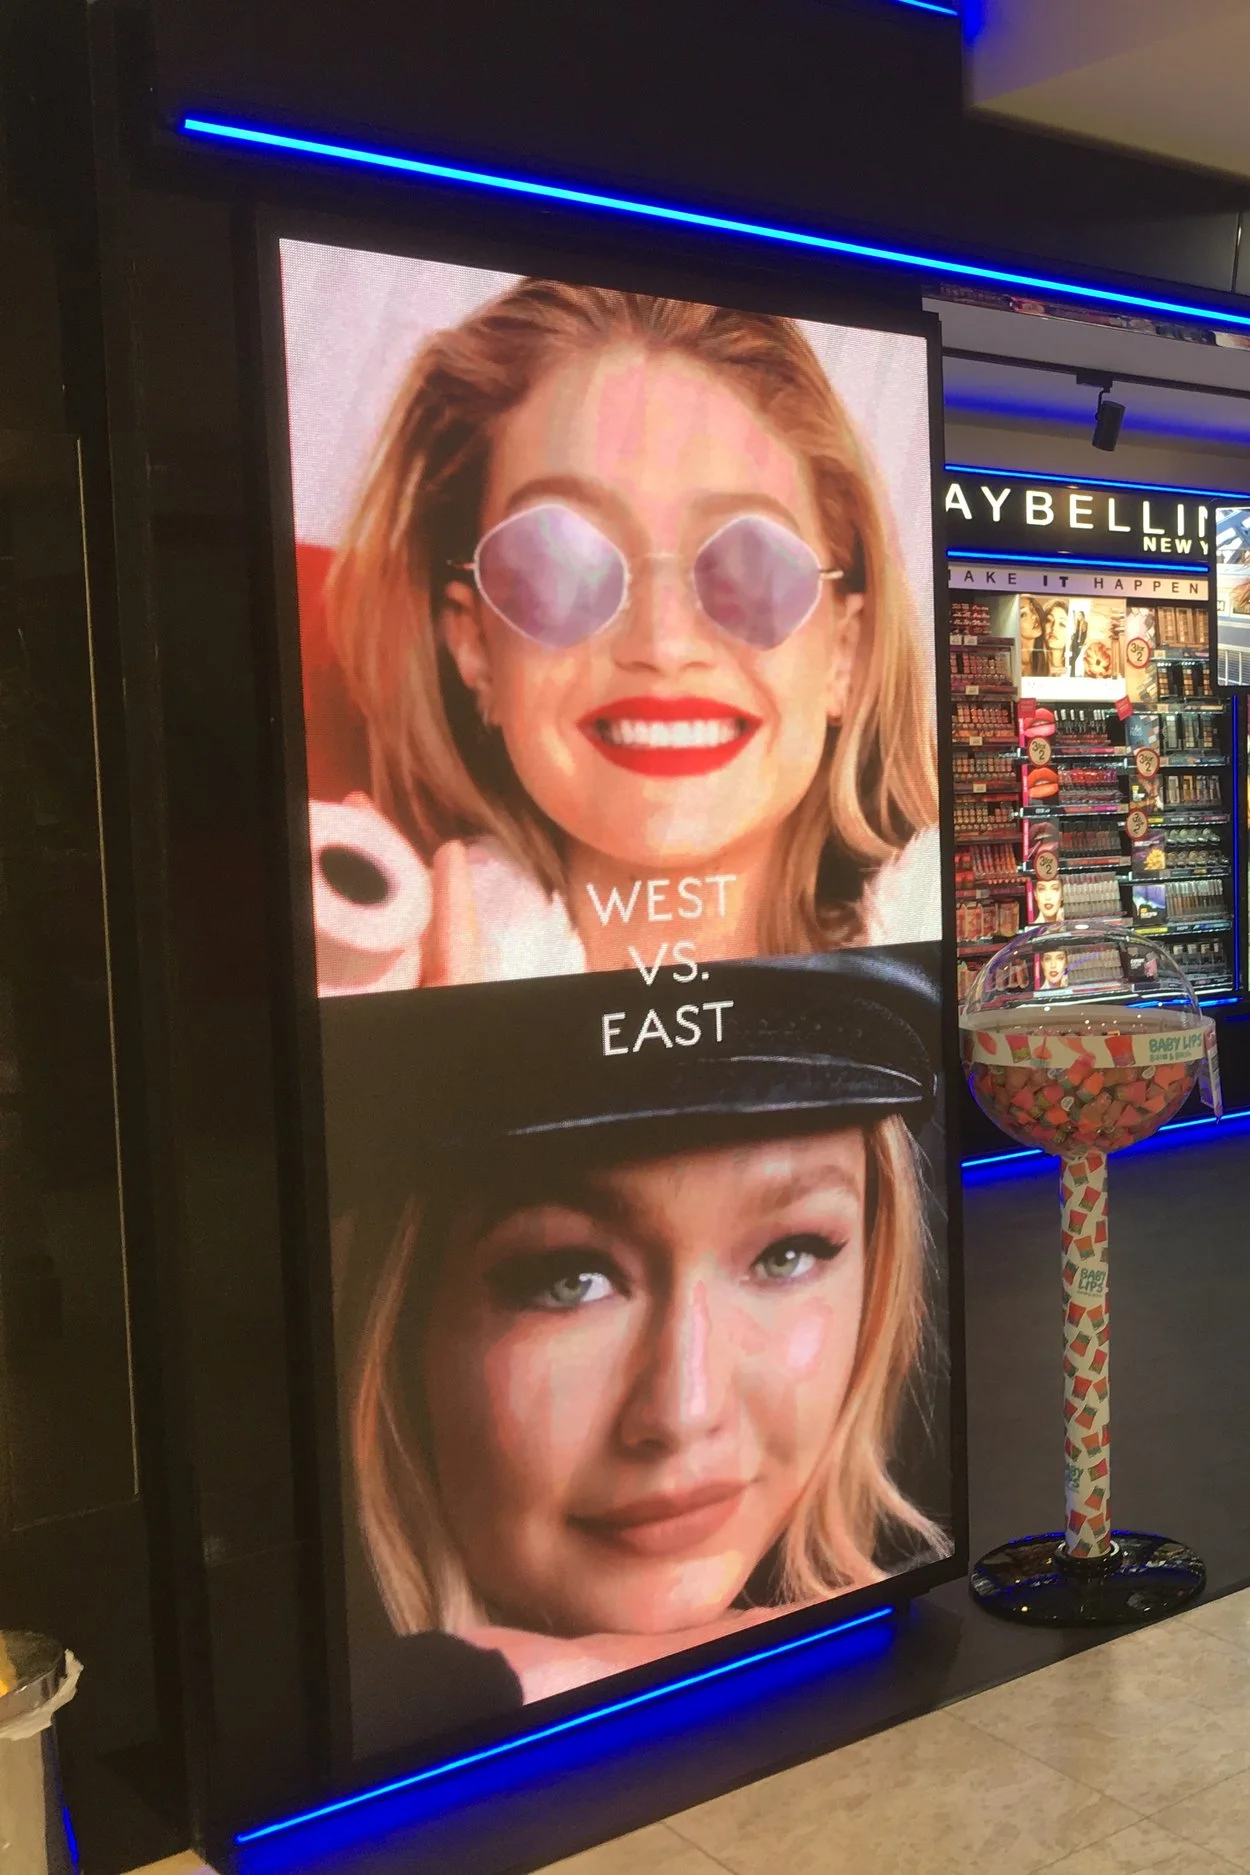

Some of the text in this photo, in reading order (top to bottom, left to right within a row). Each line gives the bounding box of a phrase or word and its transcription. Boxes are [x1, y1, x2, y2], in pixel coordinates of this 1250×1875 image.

[1142, 536, 1192, 555] NEW
[948, 568, 1199, 595] AKE IT HAPPEN
[1130, 642, 1137, 653] 3
[1136, 651, 1143, 662] 2
[1031, 740, 1039, 752] 3
[1038, 749, 1045, 760] 2
[1139, 753, 1145, 764] 3
[1145, 761, 1152, 772] 2
[1039, 855, 1046, 867] 3
[1046, 864, 1053, 875] 2
[585, 874, 737, 927] WEST
[626, 939, 710, 986] VS.
[602, 1000, 735, 1057] EAST
[1148, 1033, 1202, 1053] BABY LIPS
[1080, 1267, 1107, 1283] BABY
[1078, 1279, 1104, 1293] LIPS
